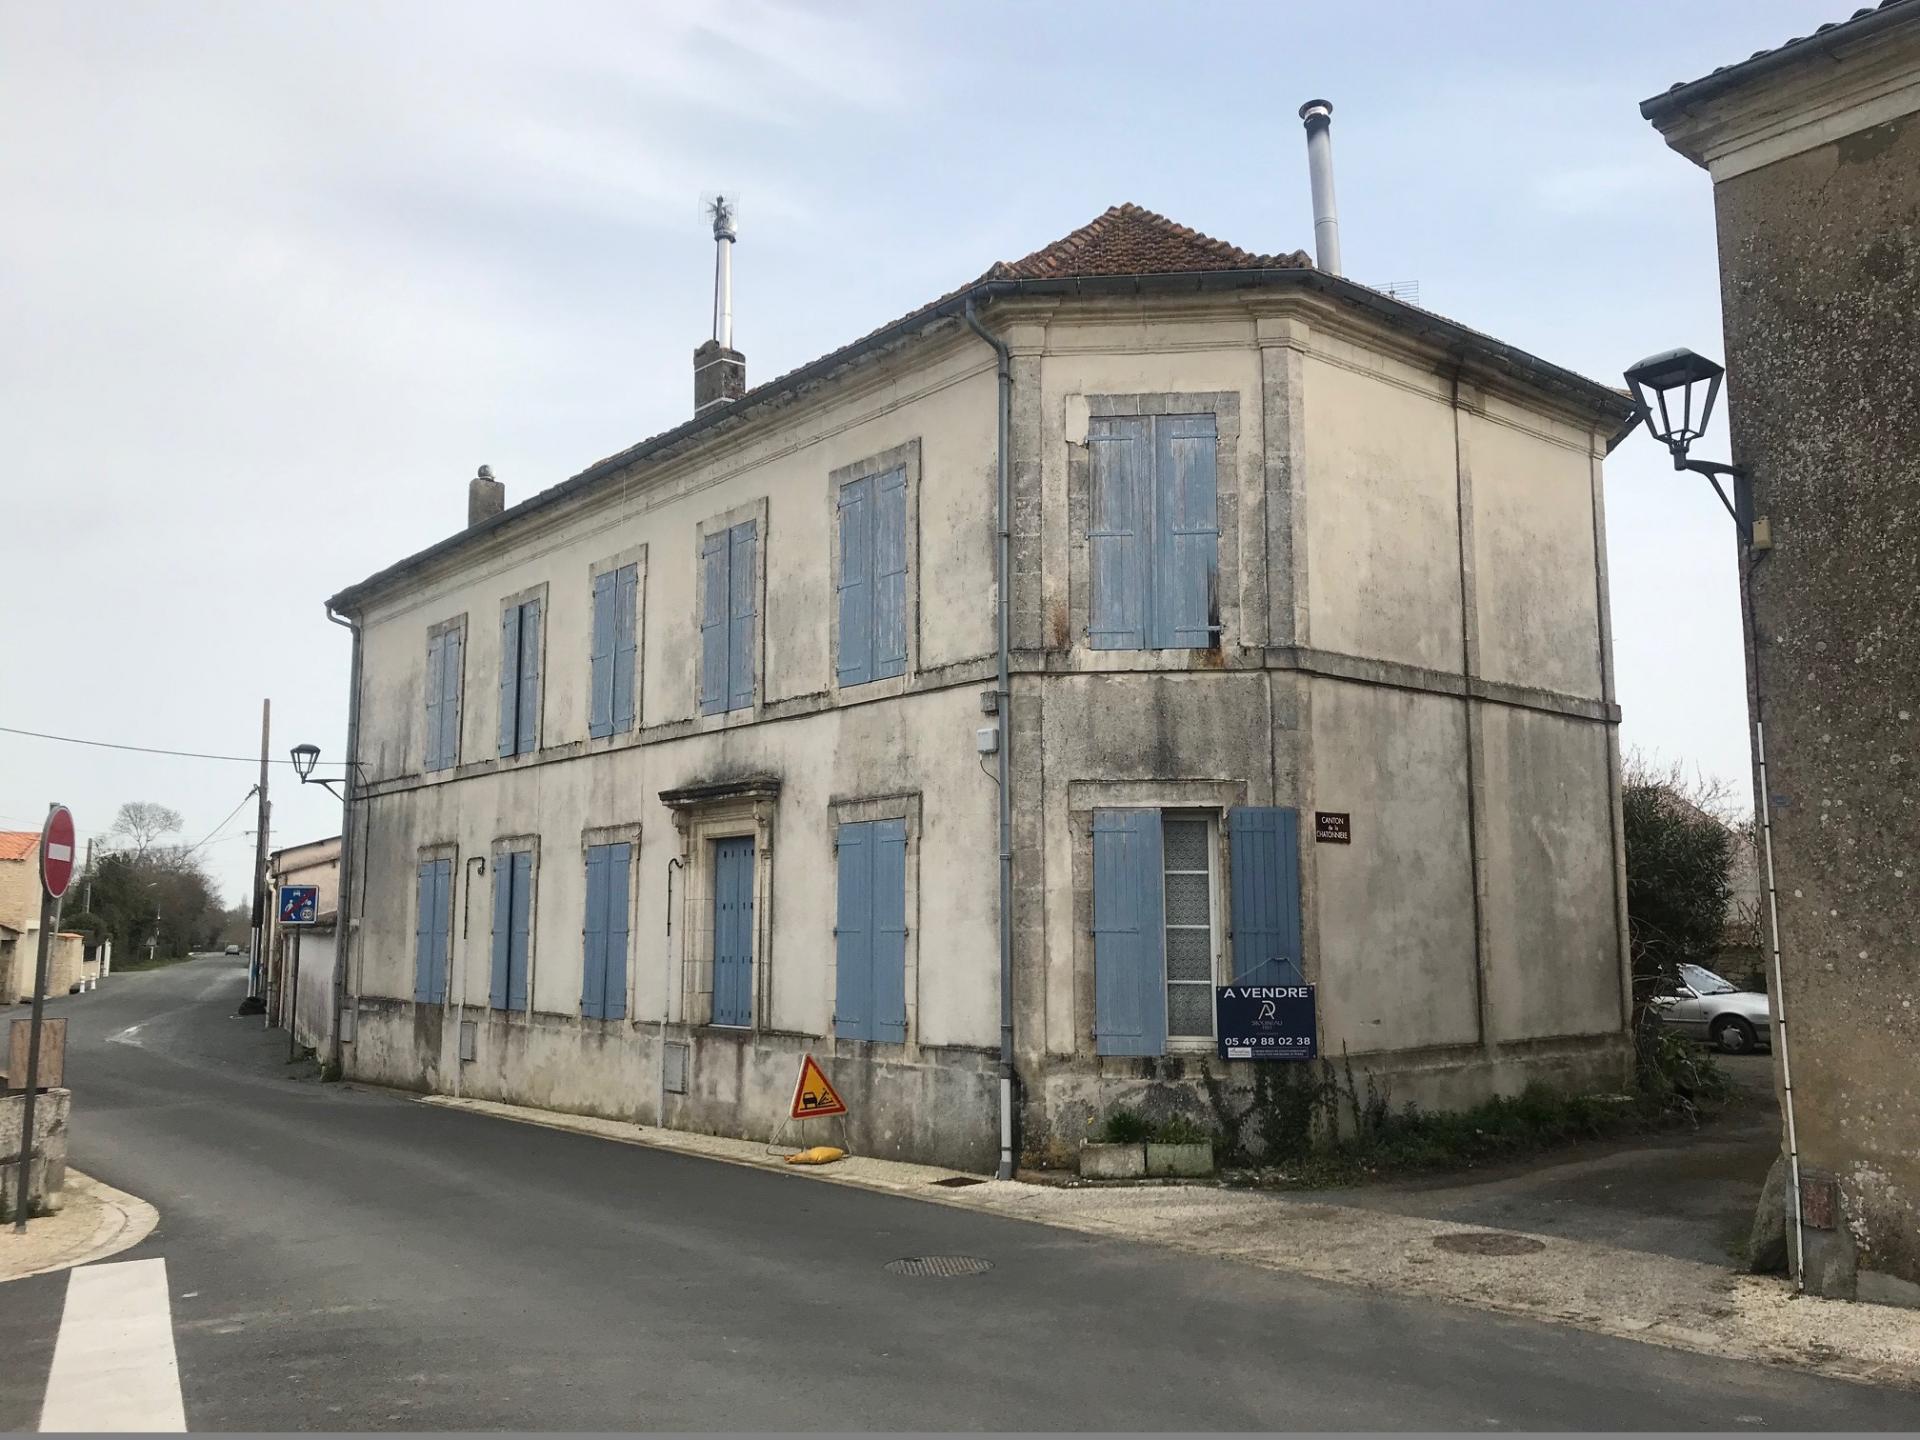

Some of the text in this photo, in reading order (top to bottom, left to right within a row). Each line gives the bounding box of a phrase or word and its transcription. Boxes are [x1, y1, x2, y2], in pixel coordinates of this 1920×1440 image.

[1321, 816, 1344, 825] CANTON
[1224, 987, 1308, 998] A VENDRE
[1224, 1037, 1311, 1046] 05 49 88 02 38
